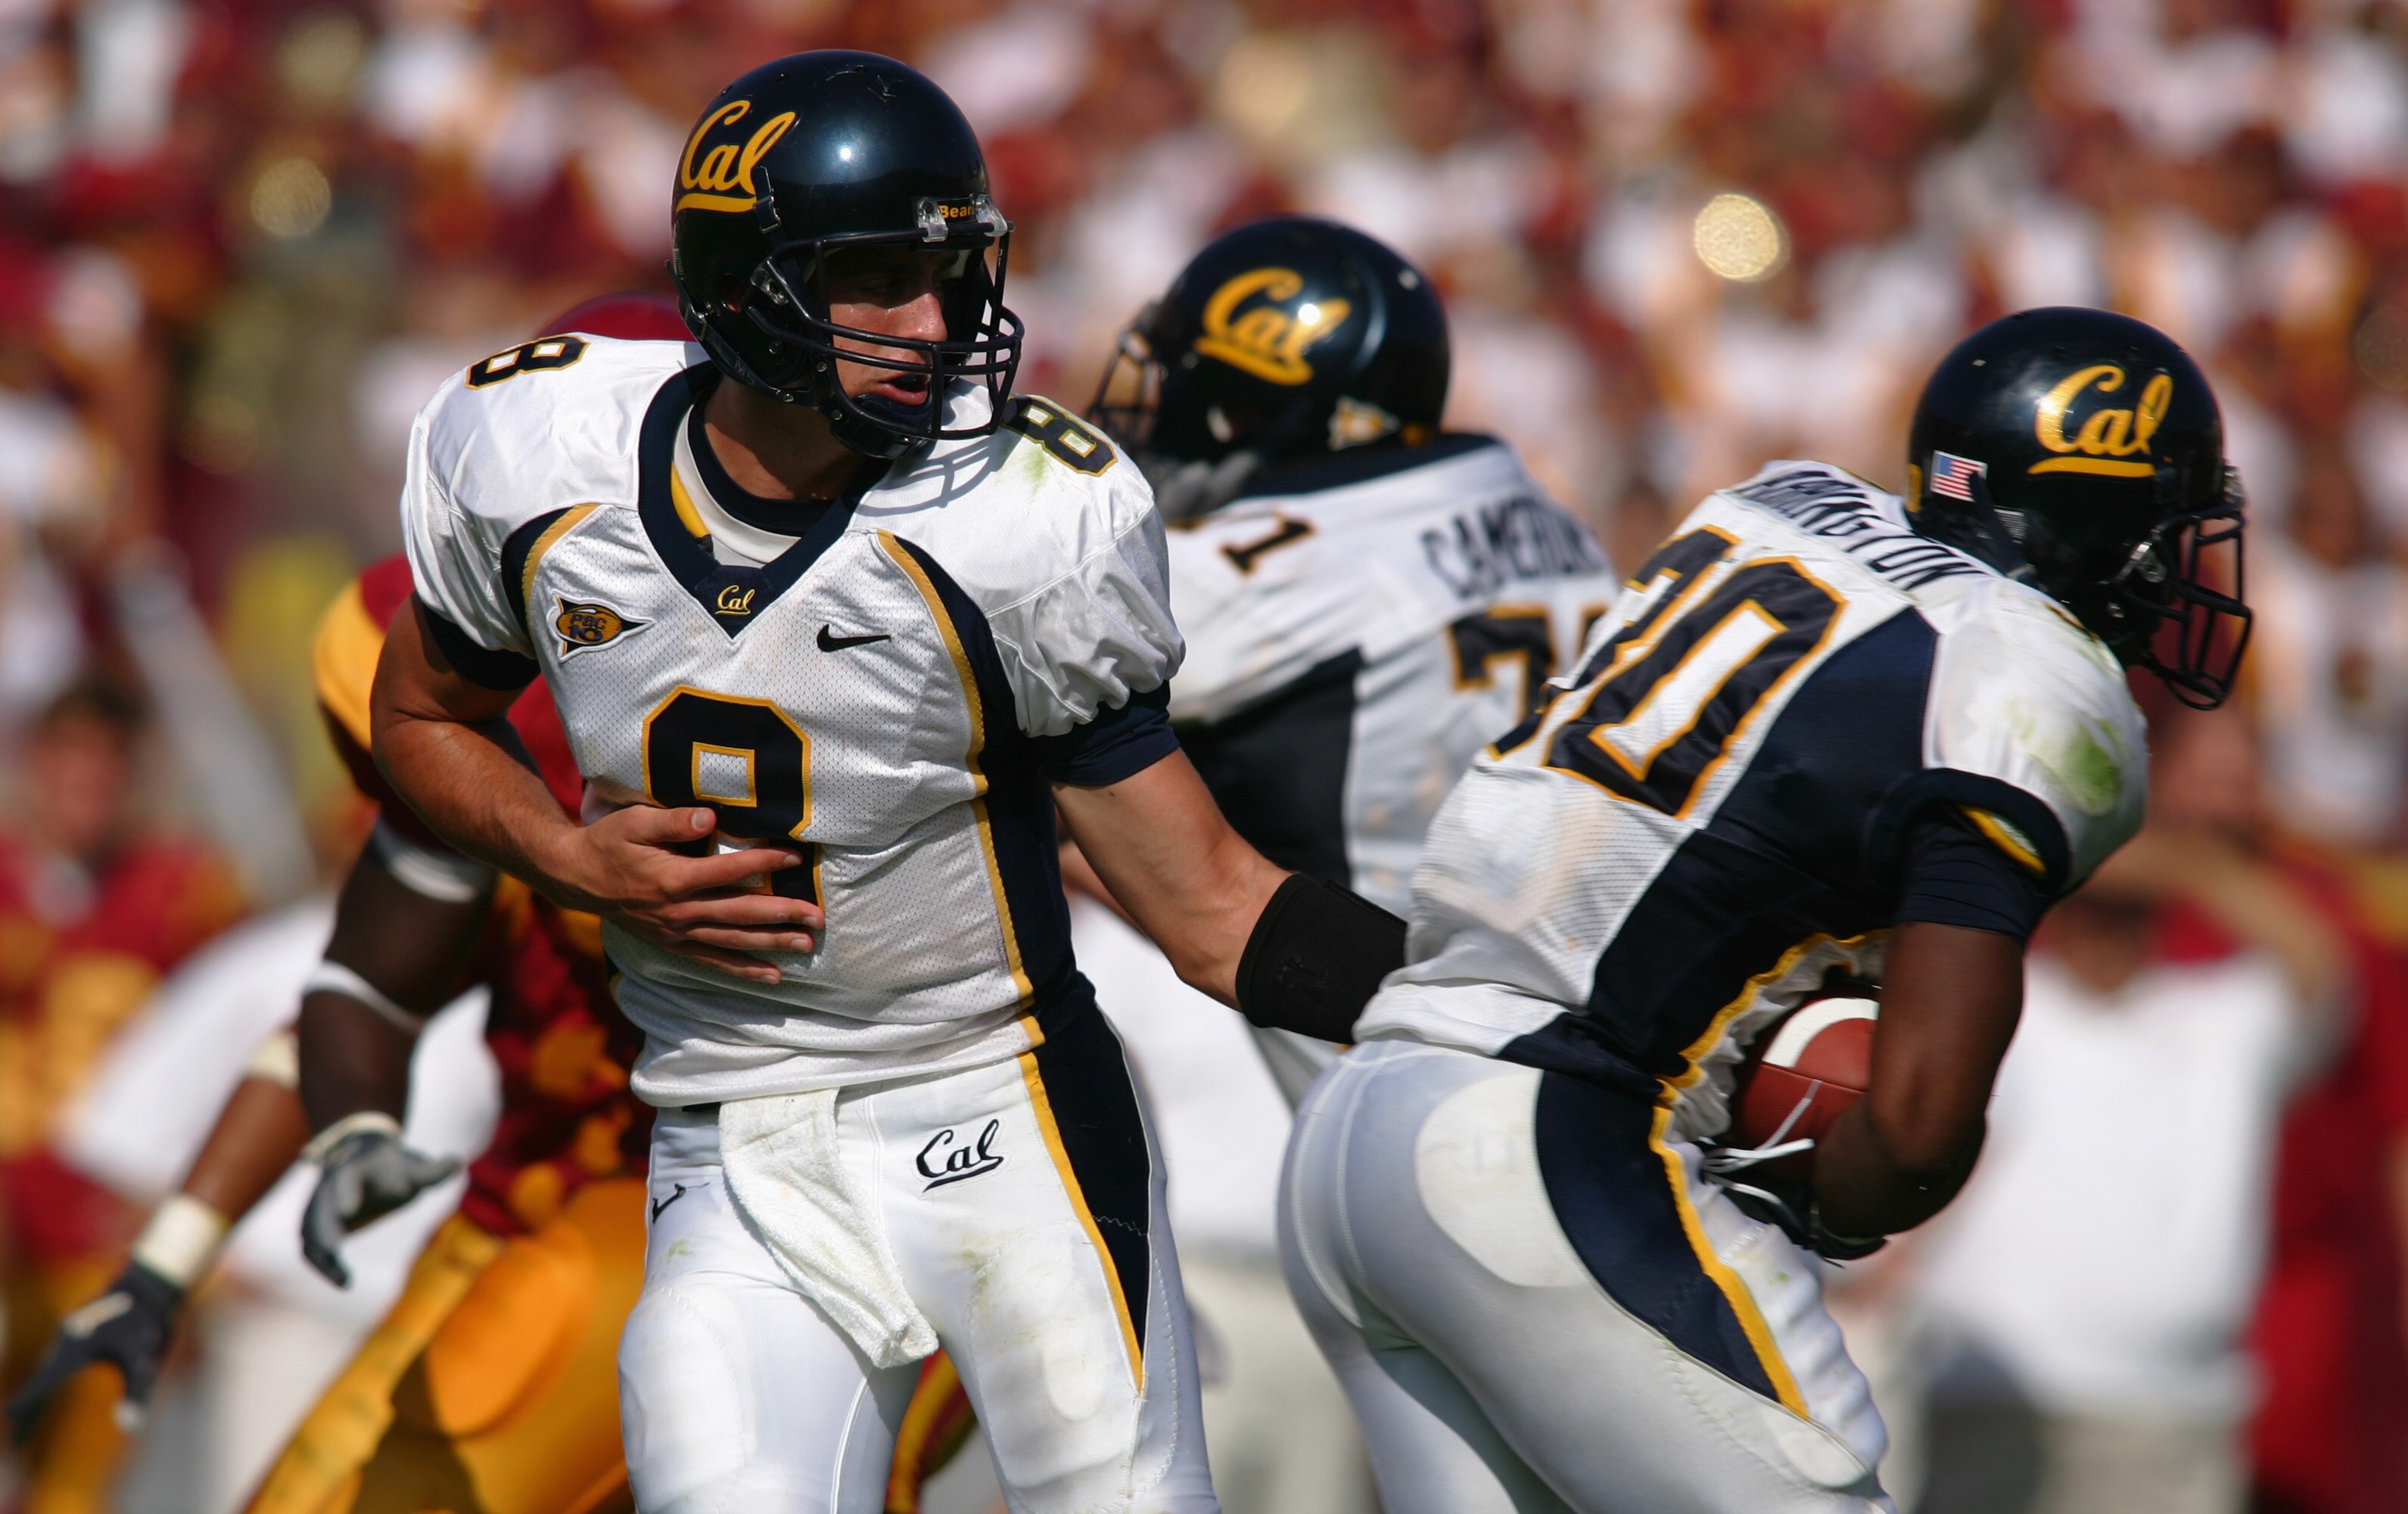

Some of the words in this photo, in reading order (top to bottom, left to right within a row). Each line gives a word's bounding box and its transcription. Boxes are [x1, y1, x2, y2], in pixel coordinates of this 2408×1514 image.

[677, 99, 796, 213] Cal
[465, 334, 592, 390] 8
[1195, 266, 1352, 385] Cal
[1000, 394, 1118, 477] 8
[2027, 365, 2173, 477] Cal
[568, 624, 603, 642] 10
[714, 585, 755, 614] Cal
[916, 1118, 1004, 1193] Cal
